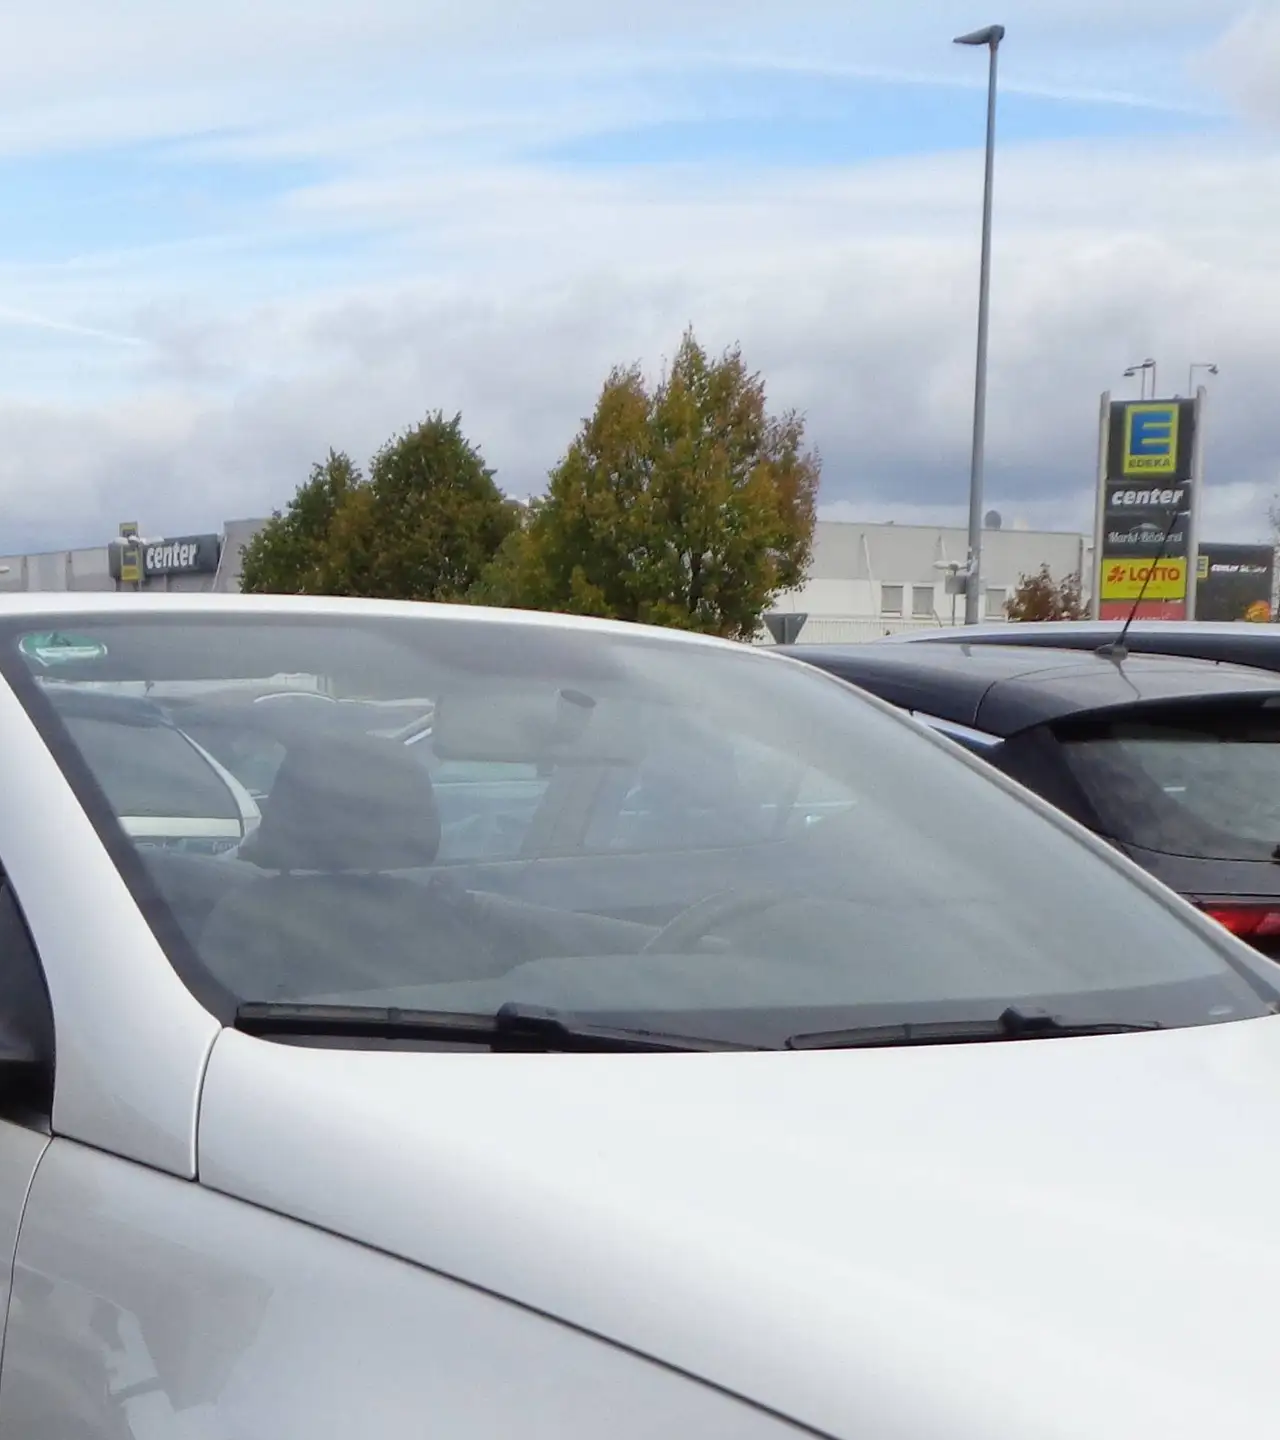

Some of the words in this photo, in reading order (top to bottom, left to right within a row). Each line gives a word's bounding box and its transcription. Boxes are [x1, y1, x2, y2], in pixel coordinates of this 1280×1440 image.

[1111, 488, 1184, 505] center
[146, 541, 197, 569] center
[1129, 566, 1181, 582] LOTTO
